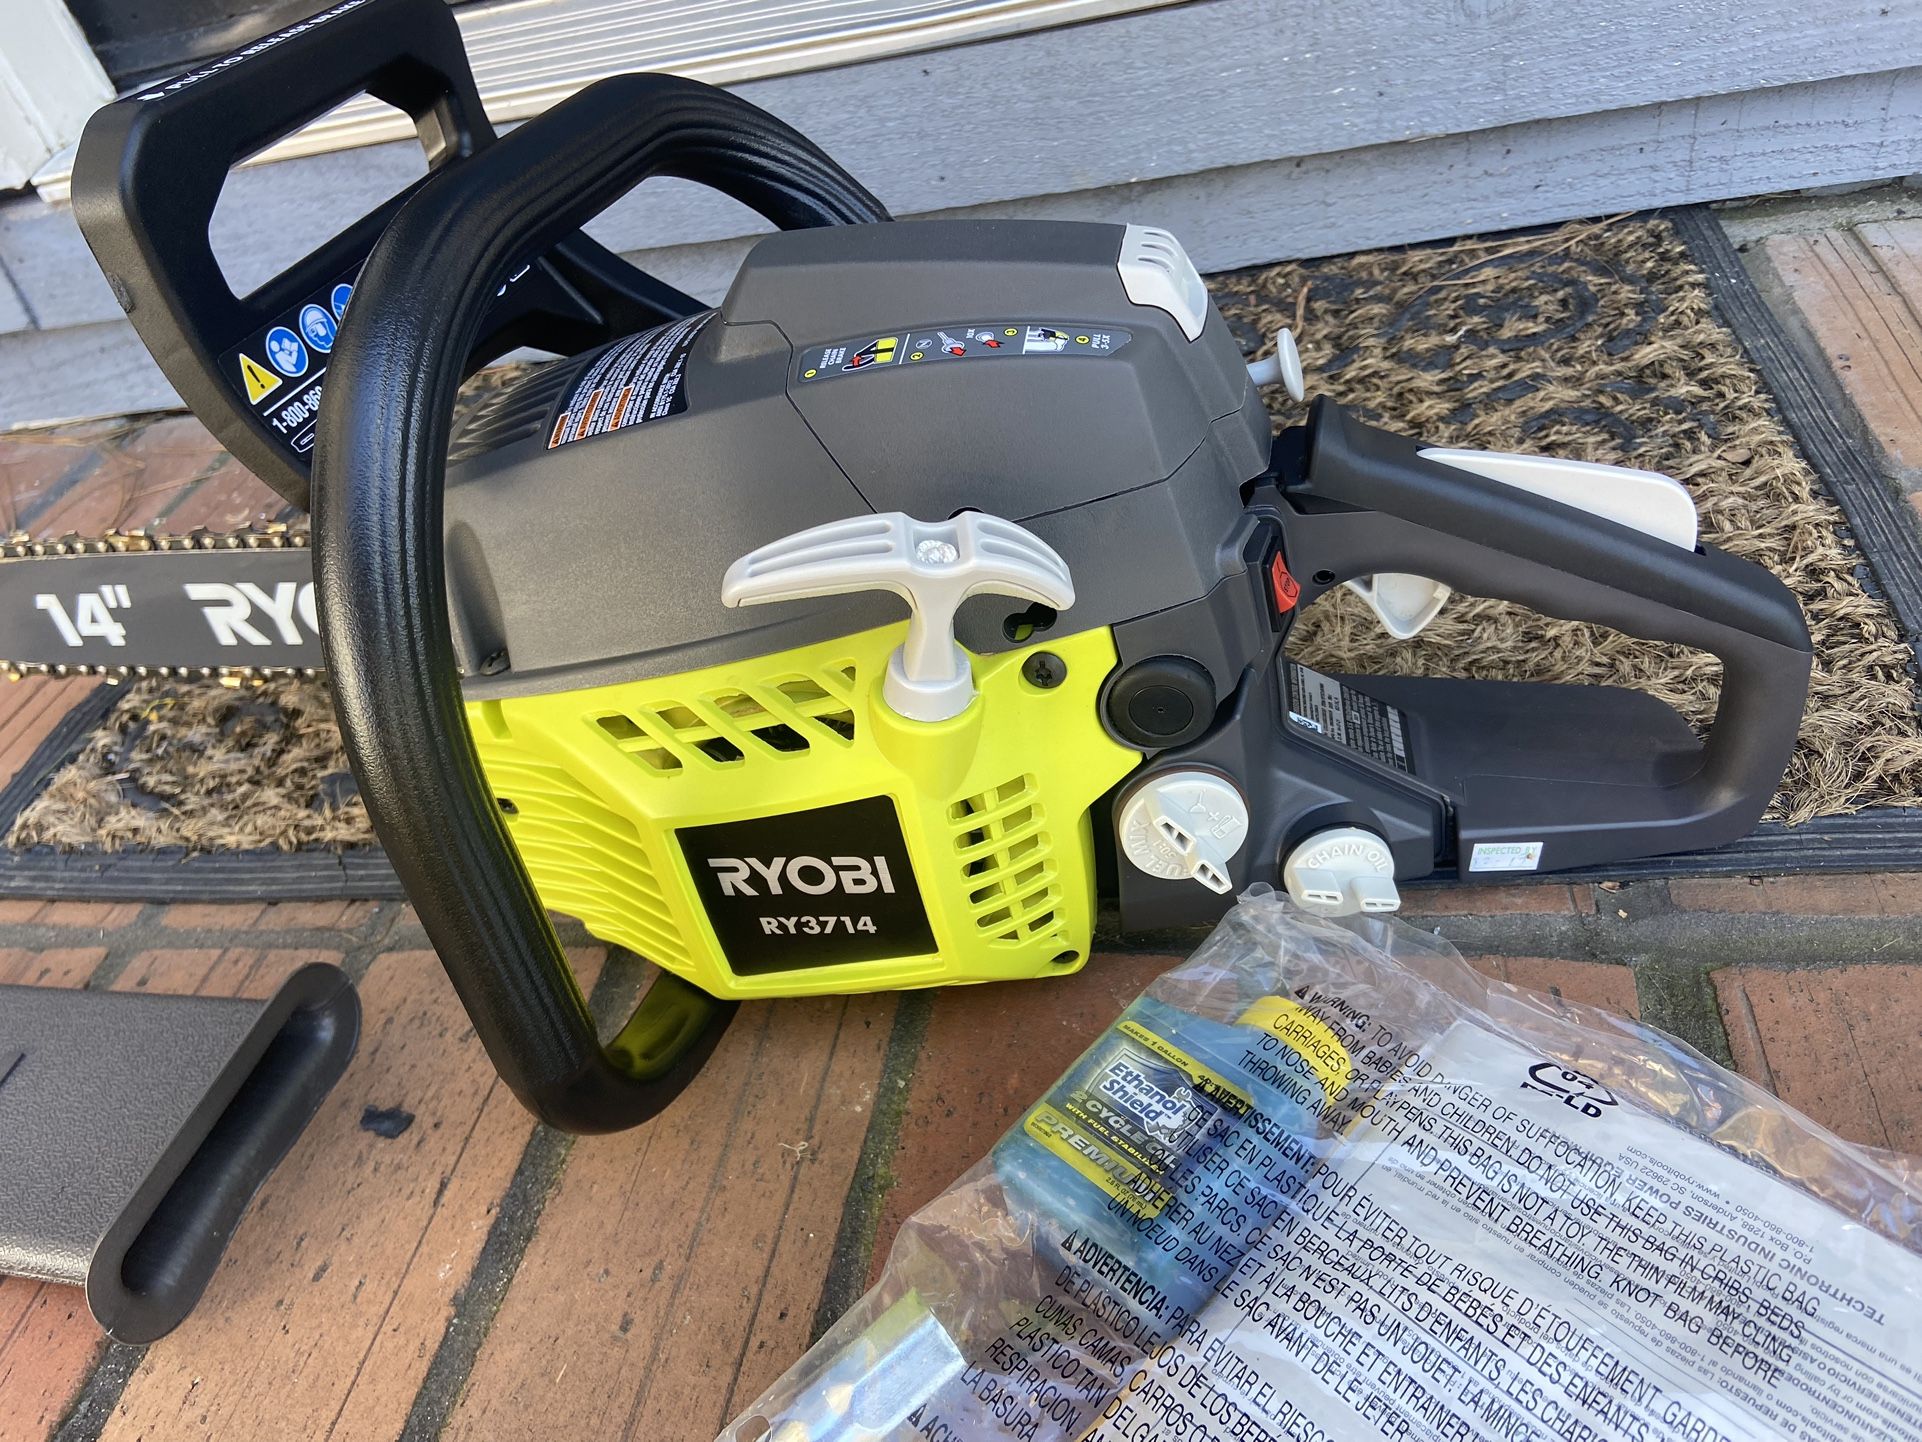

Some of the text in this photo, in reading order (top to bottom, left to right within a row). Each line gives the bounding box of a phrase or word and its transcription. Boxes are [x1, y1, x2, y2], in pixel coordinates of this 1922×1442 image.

[1091, 333, 1101, 349] PULL
[35, 584, 132, 647] 14"
[707, 855, 896, 897] RYOBI
[1307, 843, 1389, 873] CHAIN OIL
[759, 916, 878, 935] RY3714
[1108, 1058, 1186, 1117] Ethanol
[1123, 1023, 1188, 1067] MAKES GALLON
[1065, 1102, 1109, 1135] WITH FUEL
[1070, 1088, 1088, 1105] 2
[1084, 1097, 1147, 1146] CYCLE
[1237, 1049, 1352, 1135] THROWING AWAY.
[1207, 1083, 1519, 1308] AVERTISSEMENT: POUR ÉVITER TOUT RISQUE
[1272, 1011, 1347, 1076] CARRIAGES,
[1343, 1065, 1372, 1091] OR
[1435, 1124, 1473, 1157] THIS
[1467, 1146, 1504, 1182] BAG
[1496, 1169, 1518, 1195] IS
[1511, 1182, 1551, 1219] NOT
[1542, 1206, 1561, 1226] A
[1555, 1214, 1592, 1247] TOY.
[1590, 1235, 1627, 1265] THE
[1623, 1253, 1665, 1285] THIN
[1663, 1273, 1707, 1306] FILM
[1702, 1294, 1742, 1327] MAY
[1738, 1319, 1797, 1366] CLING
[1324, 1018, 1366, 1059] FROM
[1361, 1049, 1411, 1088] BABIES
[1407, 1079, 1442, 1109] AND
[1515, 1146, 1545, 1175] DO
[1538, 1164, 1576, 1201] NOT
[1568, 1189, 1606, 1224] USE
[1601, 1212, 1643, 1244] THIS
[1641, 1233, 1680, 1263] BAG
[1678, 1254, 1700, 1272] IN
[1698, 1262, 1758, 1310] CRIBS,
[1370, 1024, 1394, 1049] TO
[1387, 1040, 1432, 1079] AVOID
[1490, 1103, 1517, 1127] OF
[1620, 1191, 1669, 1232] KEEP
[1666, 1220, 1708, 1251] THIS
[1705, 1242, 1783, 1292] PLASTIC
[1779, 1283, 1823, 1317] BAG
[1616, 1151, 1639, 1168] USA
[1625, 1141, 1815, 1254] 1-800-860-4050 www.ryobitools.com
[1639, 1164, 1670, 1186] 29622
[1669, 1181, 1687, 1195] SC
[1205, 1116, 1241, 1149] SAC
[1234, 1136, 1261, 1166] EN
[1254, 1153, 1339, 1230] PLASTIQUE
[1333, 1220, 1361, 1247] LA
[1356, 1236, 1419, 1280] PORTÉ
[1414, 1269, 1444, 1294] DE
[1441, 1282, 1505, 1336] BÉBÉS
[1499, 1323, 1531, 1355] ET
[1525, 1342, 1569, 1386] DES
[1255, 1031, 1786, 1389] TO NOSE AND MOUTH AND PREVENT BREATHING. KNOT BAG BEFORE
[1624, 1173, 1888, 1326] TECHTRONIC INDUSTRIES POWER
[1687, 1189, 1737, 1222] Anderson,
[1738, 1216, 1766, 1238] 1288,
[1767, 1234, 1790, 1251] Box
[1126, 1170, 1472, 1442] ADHÉRER AU NEZ ET À LA BOUCHE ET ENTRAINER
[1147, 1146, 1175, 1173] OU
[1167, 1162, 1203, 1197] LES
[1194, 1183, 1250, 1237] PARCS.
[1243, 1224, 1272, 1254] CE
[1266, 1241, 1302, 1274] SAC
[1298, 1262, 1350, 1301] N'EST
[1343, 1289, 1382, 1326] PAS
[1375, 1312, 1407, 1347] UN
[1456, 1379, 1488, 1413] LA
[1167, 1125, 1545, 1412] UTILISER CE SAC EN BERCEAUX, LITS D'ENFANTS, LES
[1008, 1312, 1111, 1409] PLASTICO TAN
[1054, 1264, 1239, 1427] DE PLASTICO LEJOS DE LOS
[1072, 1235, 1281, 1414] ADVERTENCIA: PARA EVITAR EL
[1106, 1191, 1411, 1442] UN NOEUD DANS LE SAC AVANT DE LE JETER
[959, 1359, 1041, 1442] LA BASURA
[984, 1334, 1085, 1437] RESPIRACION.
[1033, 1292, 1196, 1438] CUNAS, CAMAS, CARROS
